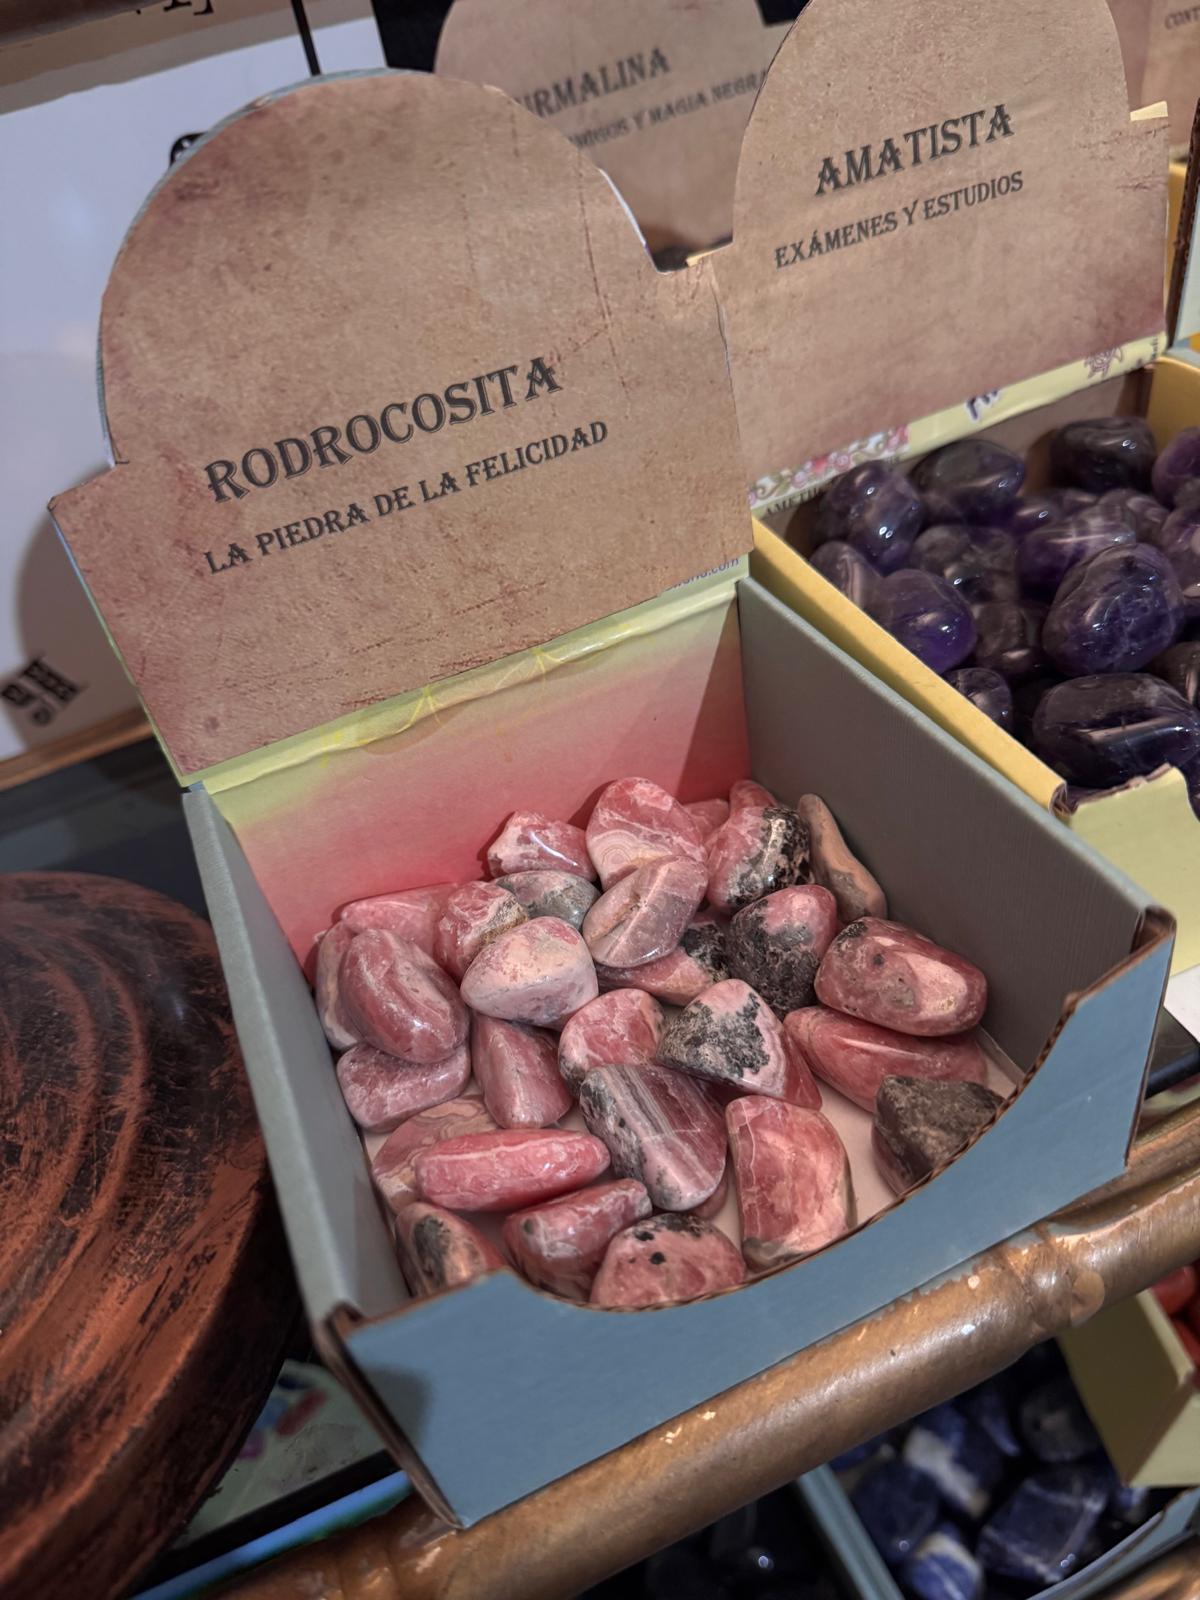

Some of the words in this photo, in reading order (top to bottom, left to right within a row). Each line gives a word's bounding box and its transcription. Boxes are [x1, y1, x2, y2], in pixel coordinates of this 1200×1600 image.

[649, 92, 707, 124] MAGIA
[814, 103, 1015, 196] AMATISTA
[774, 211, 898, 269] EXÁMENES
[902, 200, 919, 226] Y
[923, 170, 1024, 220] ESTUDIOS
[203, 356, 563, 503] RODROCOSITA
[203, 542, 253, 575] LA
[255, 502, 370, 556] PIEDRA
[374, 485, 417, 518] DE
[419, 471, 461, 502] LA
[465, 420, 609, 488] FELICIDAD
